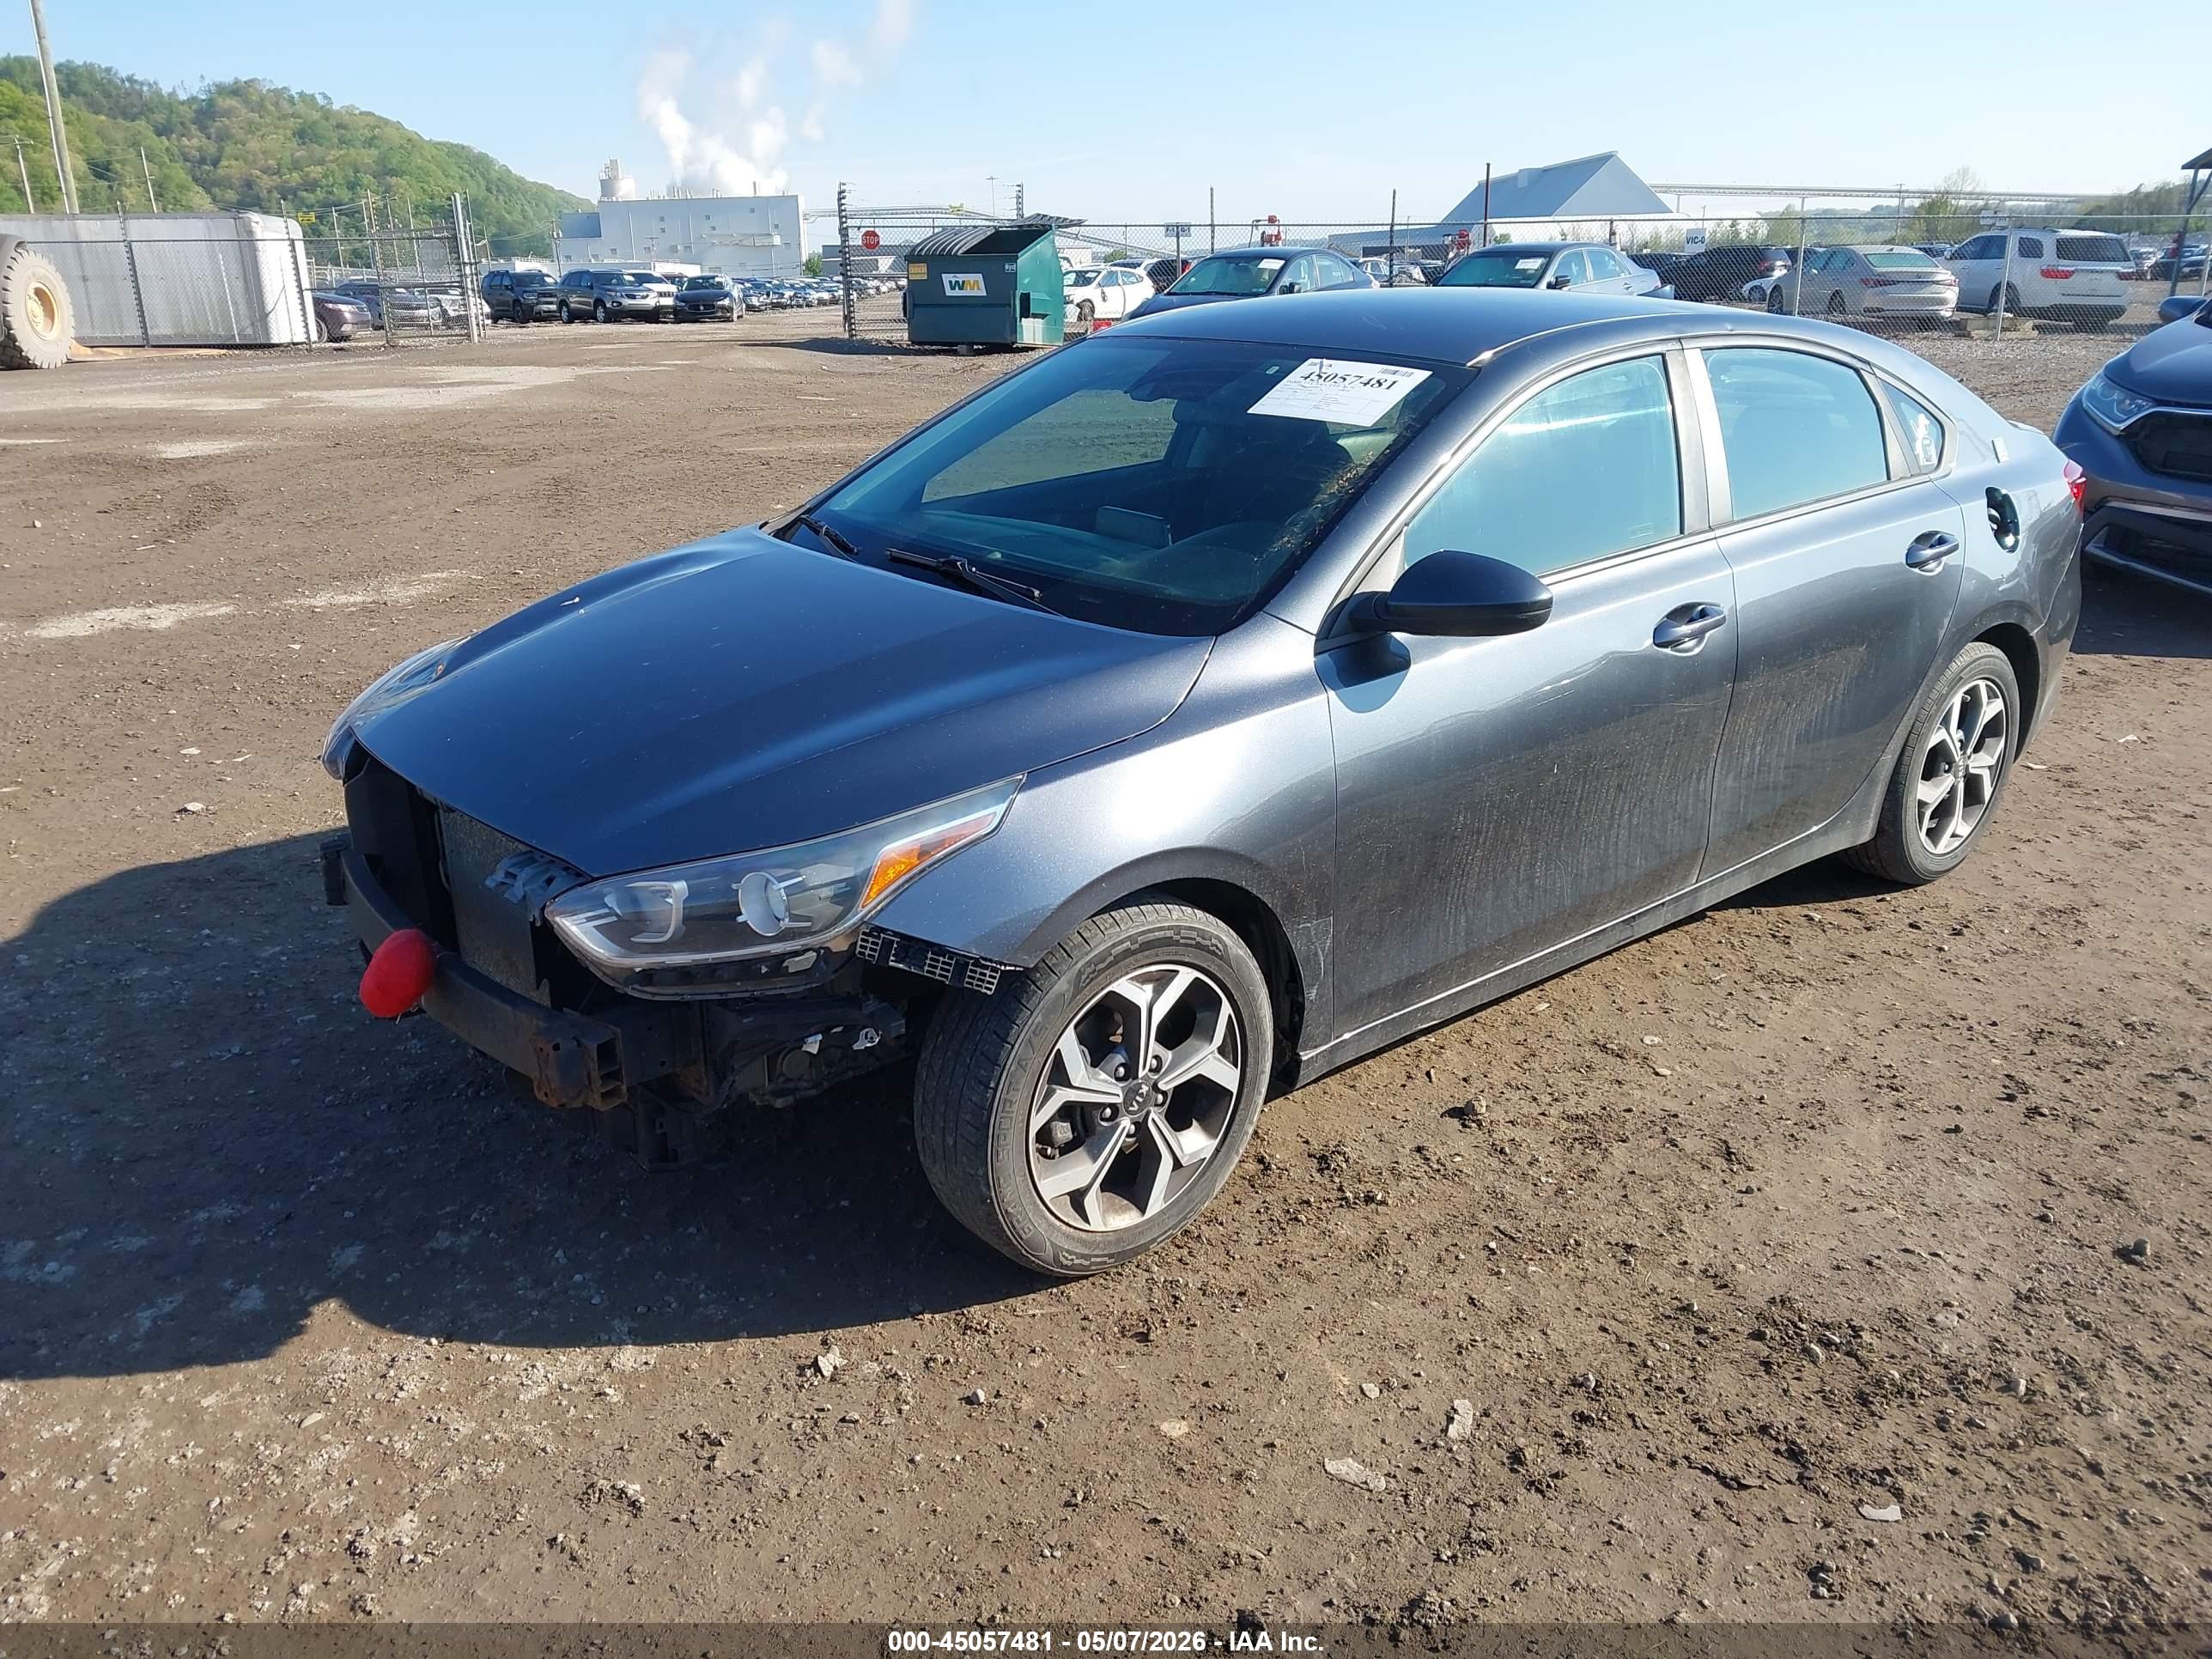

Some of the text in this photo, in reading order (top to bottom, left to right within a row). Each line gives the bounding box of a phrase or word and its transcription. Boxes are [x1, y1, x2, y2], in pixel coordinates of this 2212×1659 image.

[862, 235, 879, 245] STOP
[421, 248, 446, 260] STOP
[948, 279, 981, 291] WM
[1299, 370, 1399, 391] 45057481
[1127, 1083, 1150, 1112] KIA
[996, 1078, 1024, 1164] SPORT
